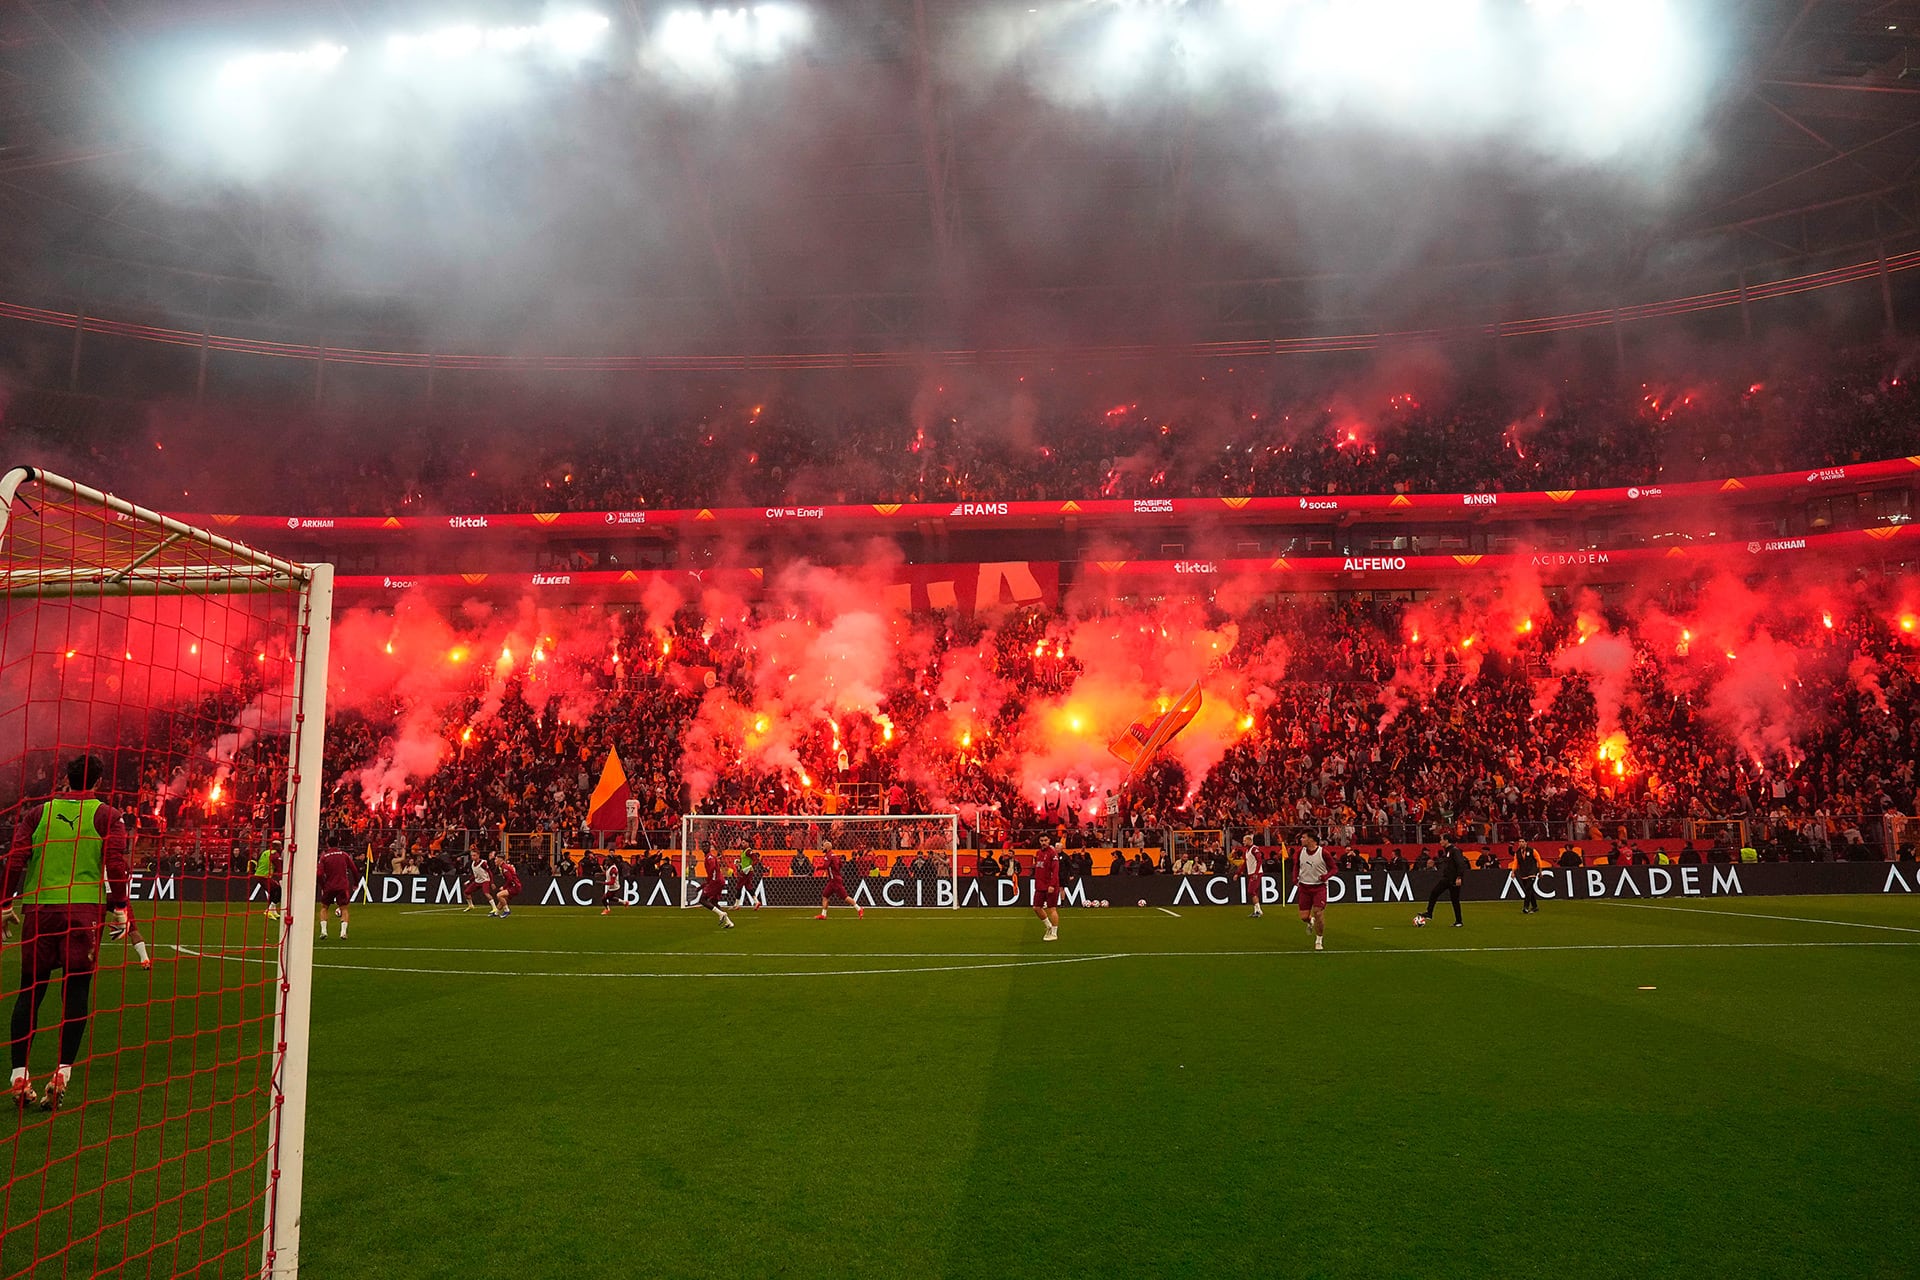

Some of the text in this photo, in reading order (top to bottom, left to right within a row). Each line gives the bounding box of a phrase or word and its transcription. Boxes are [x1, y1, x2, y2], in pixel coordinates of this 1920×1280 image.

[1820, 468, 1845, 476] BULLS
[1641, 488, 1662, 497] Lydia
[1474, 494, 1497, 504] NGN
[964, 503, 1008, 515] RAMS
[1308, 501, 1337, 509] SOCAR
[765, 508, 824, 519] CW Enerji
[302, 519, 334, 528] ARKHAM
[449, 516, 488, 528] tiktak
[1765, 539, 1806, 551] ARKHAM
[1174, 562, 1218, 574] tiktak
[1343, 557, 1406, 571] ALFEMO
[531, 573, 571, 585] ÜLKER
